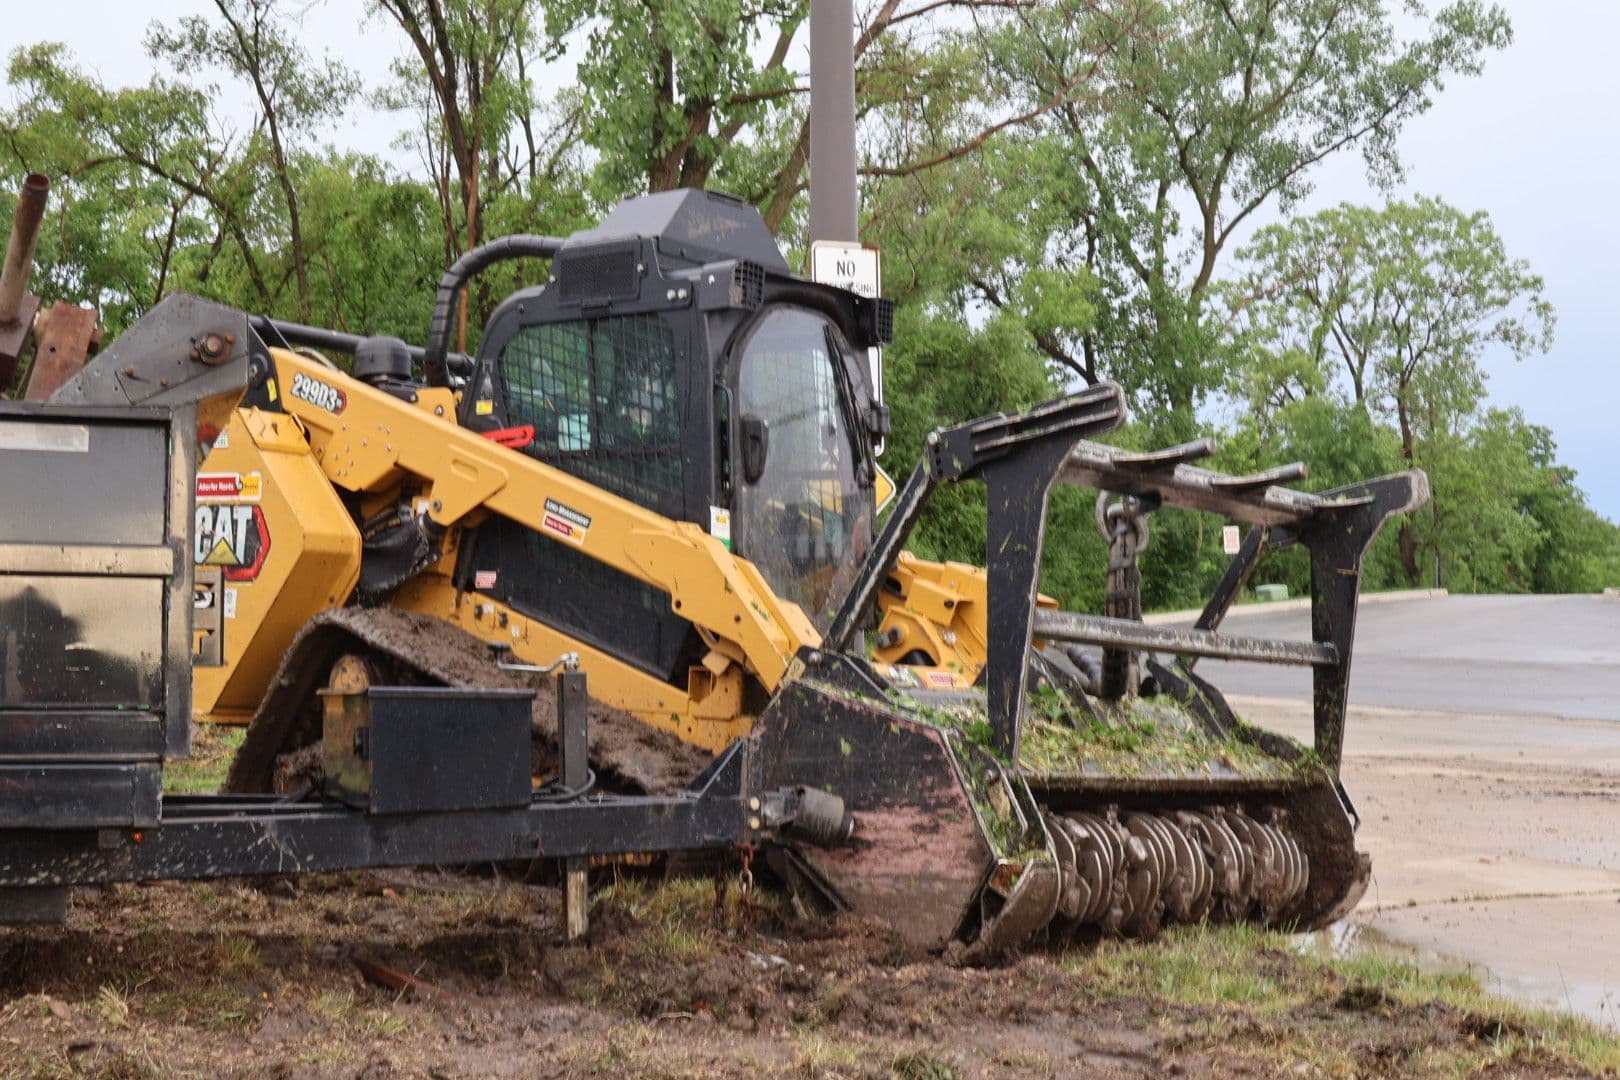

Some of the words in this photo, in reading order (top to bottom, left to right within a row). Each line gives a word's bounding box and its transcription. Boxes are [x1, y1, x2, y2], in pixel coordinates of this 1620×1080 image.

[836, 260, 856, 277] NO
[291, 372, 338, 412] 299D3
[195, 505, 252, 564] CAT
